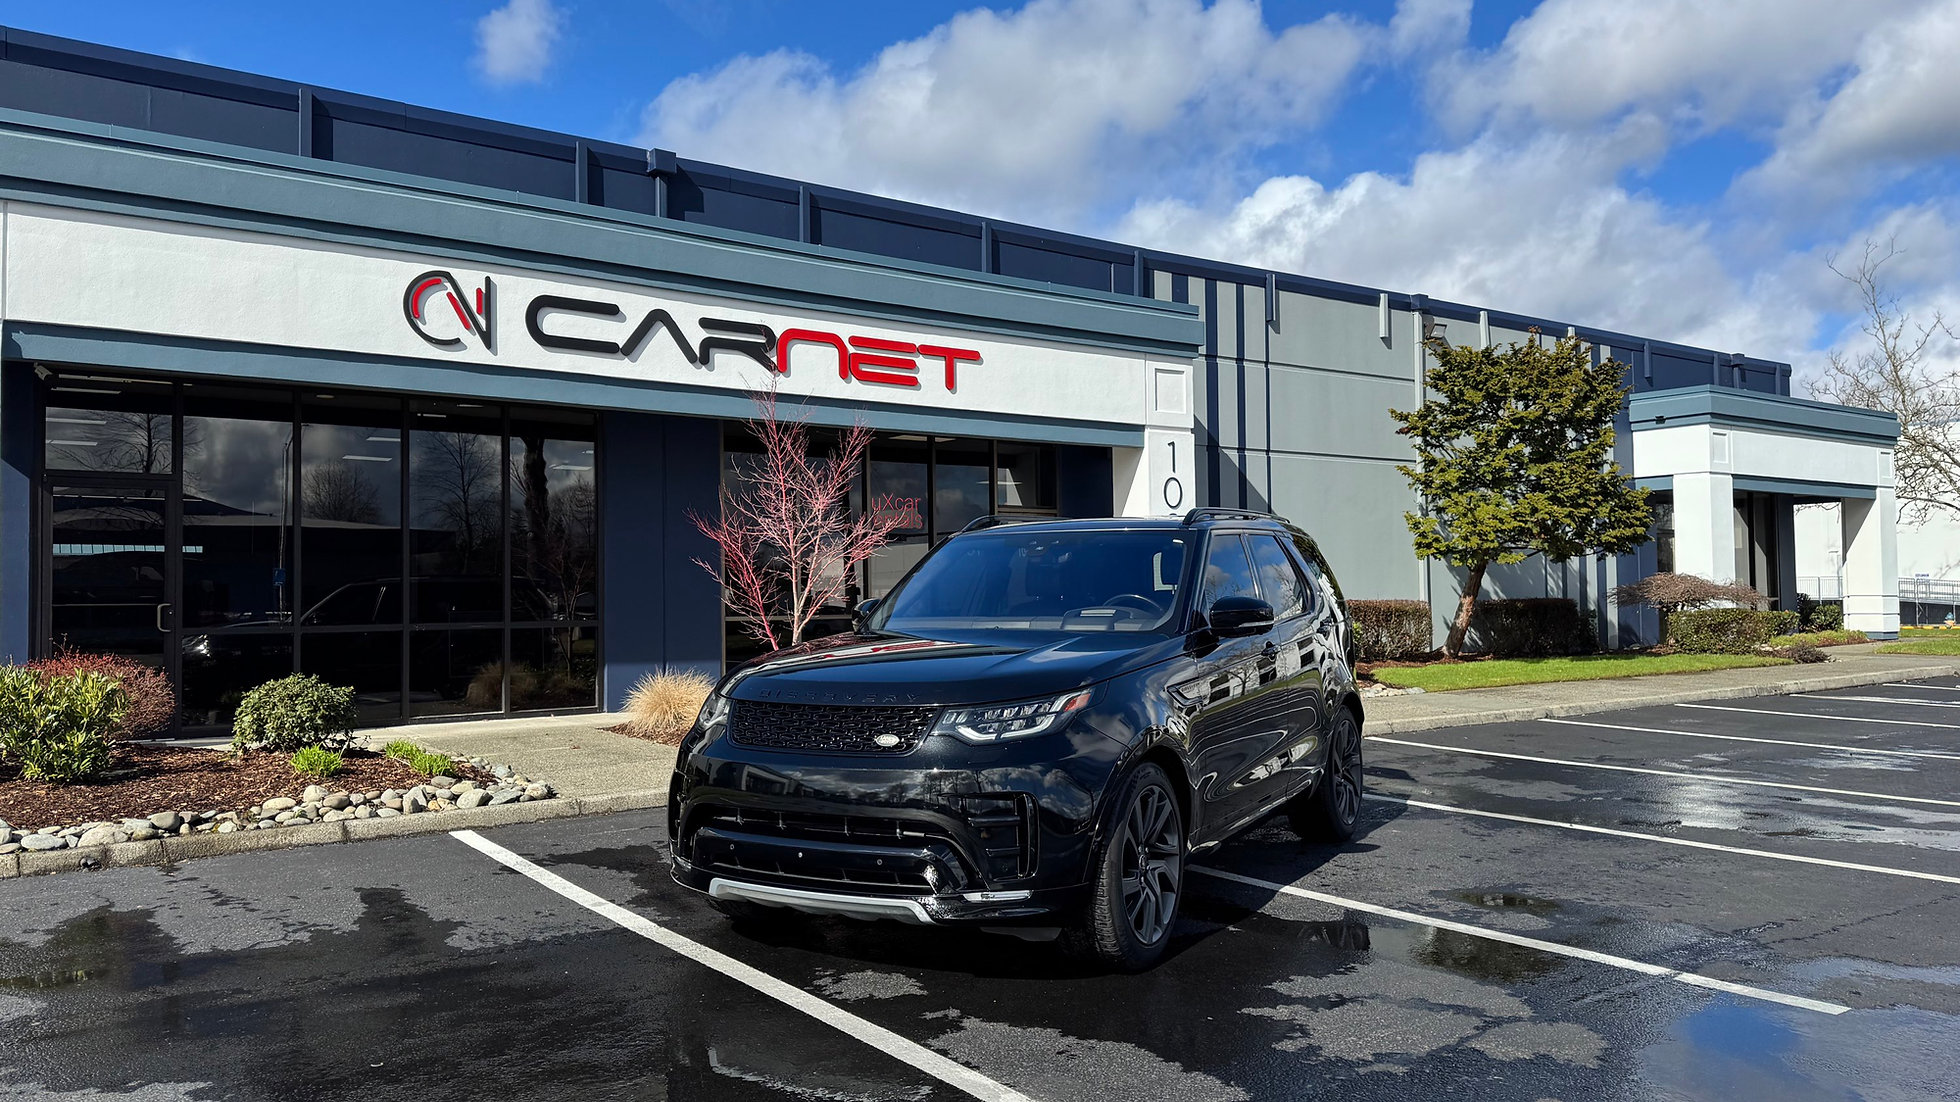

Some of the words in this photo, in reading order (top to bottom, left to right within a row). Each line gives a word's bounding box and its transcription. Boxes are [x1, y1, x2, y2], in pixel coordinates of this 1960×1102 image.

[525, 294, 981, 391] CARNET
[1163, 441, 1183, 515] 10
[871, 493, 921, 511] uXcar
[873, 512, 923, 529] entals
